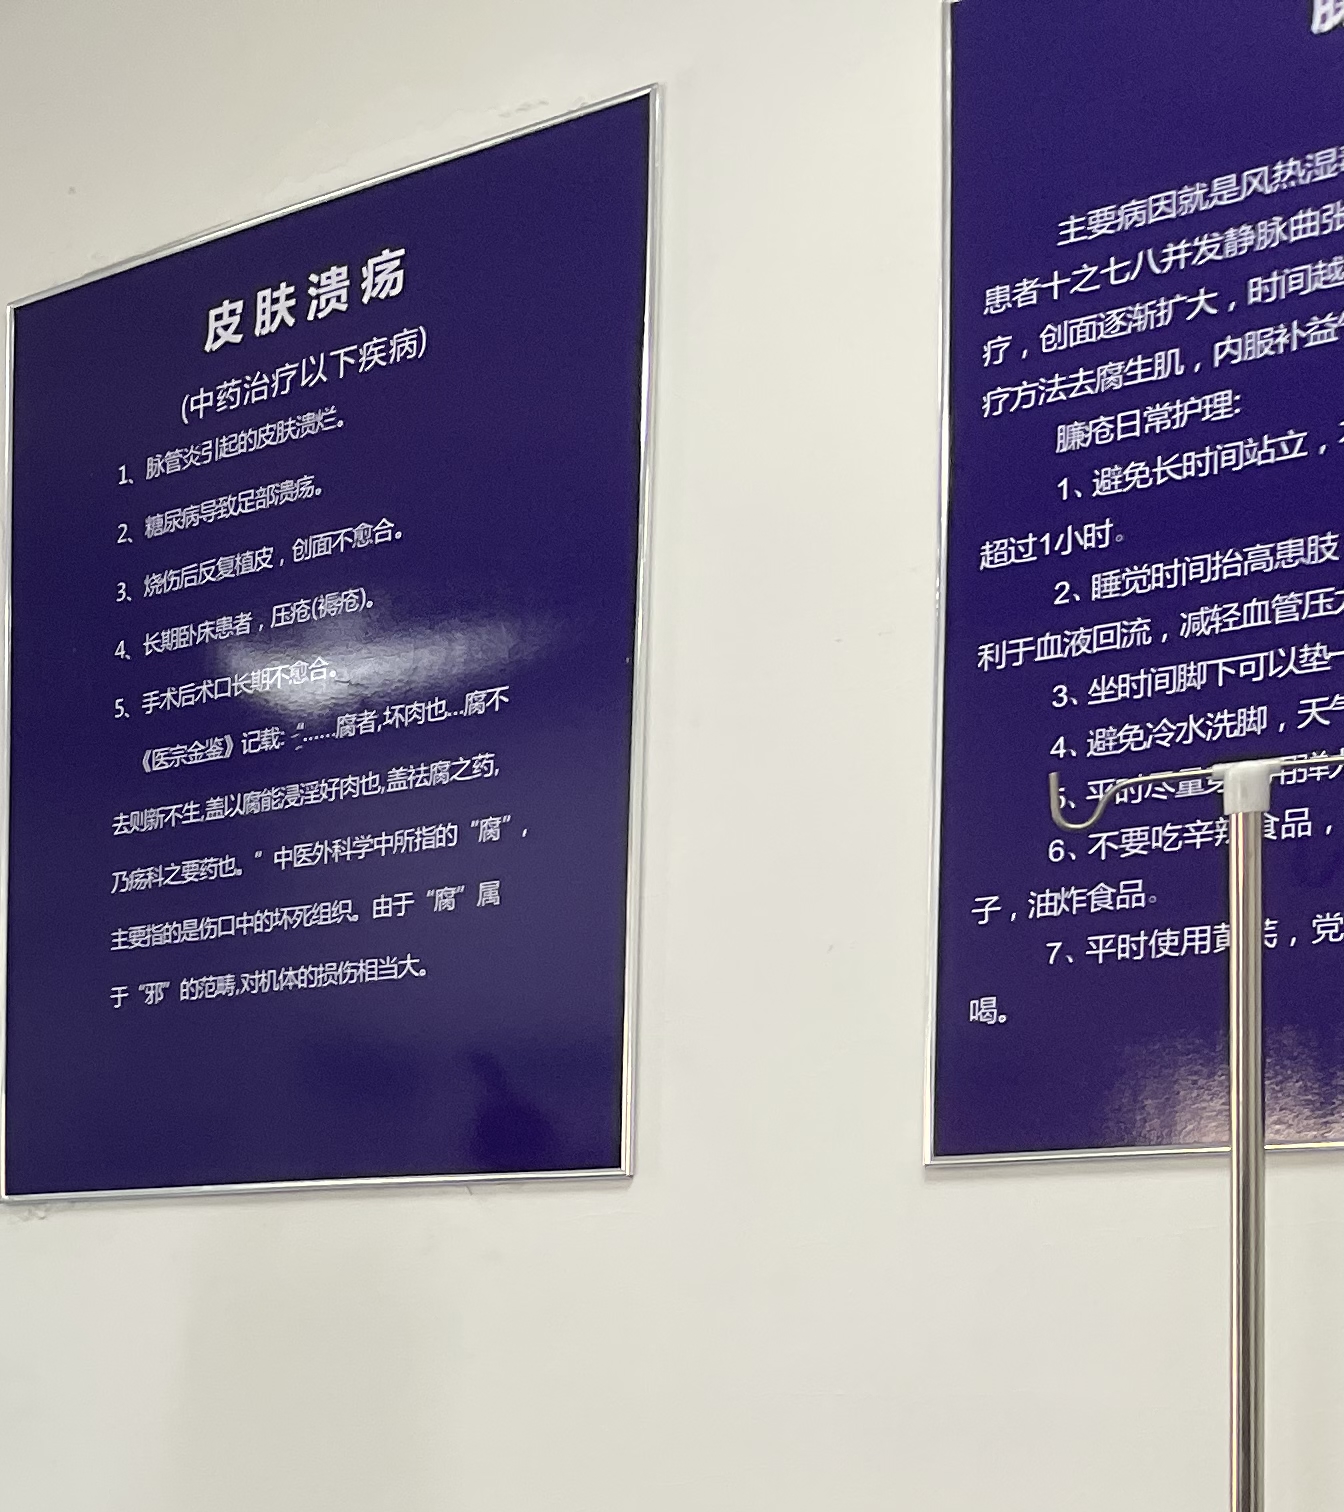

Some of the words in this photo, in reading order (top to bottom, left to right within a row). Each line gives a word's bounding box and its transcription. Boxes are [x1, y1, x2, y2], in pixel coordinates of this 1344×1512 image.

[1056, 145, 1344, 247] 主要病因就是风热湿
[204, 246, 407, 353] 皮肤溃疡
[180, 326, 429, 425] (中药治疗以下疾病)
[981, 311, 1344, 418] 疗方法去腐生肌，内服补益
[1056, 420, 1344, 500] 1、避免长时间站立，
[979, 518, 1124, 571] 超过1小时。
[977, 586, 1344, 672] 利于血液回流，减轻血管压
[969, 996, 1008, 1025] 喝。
